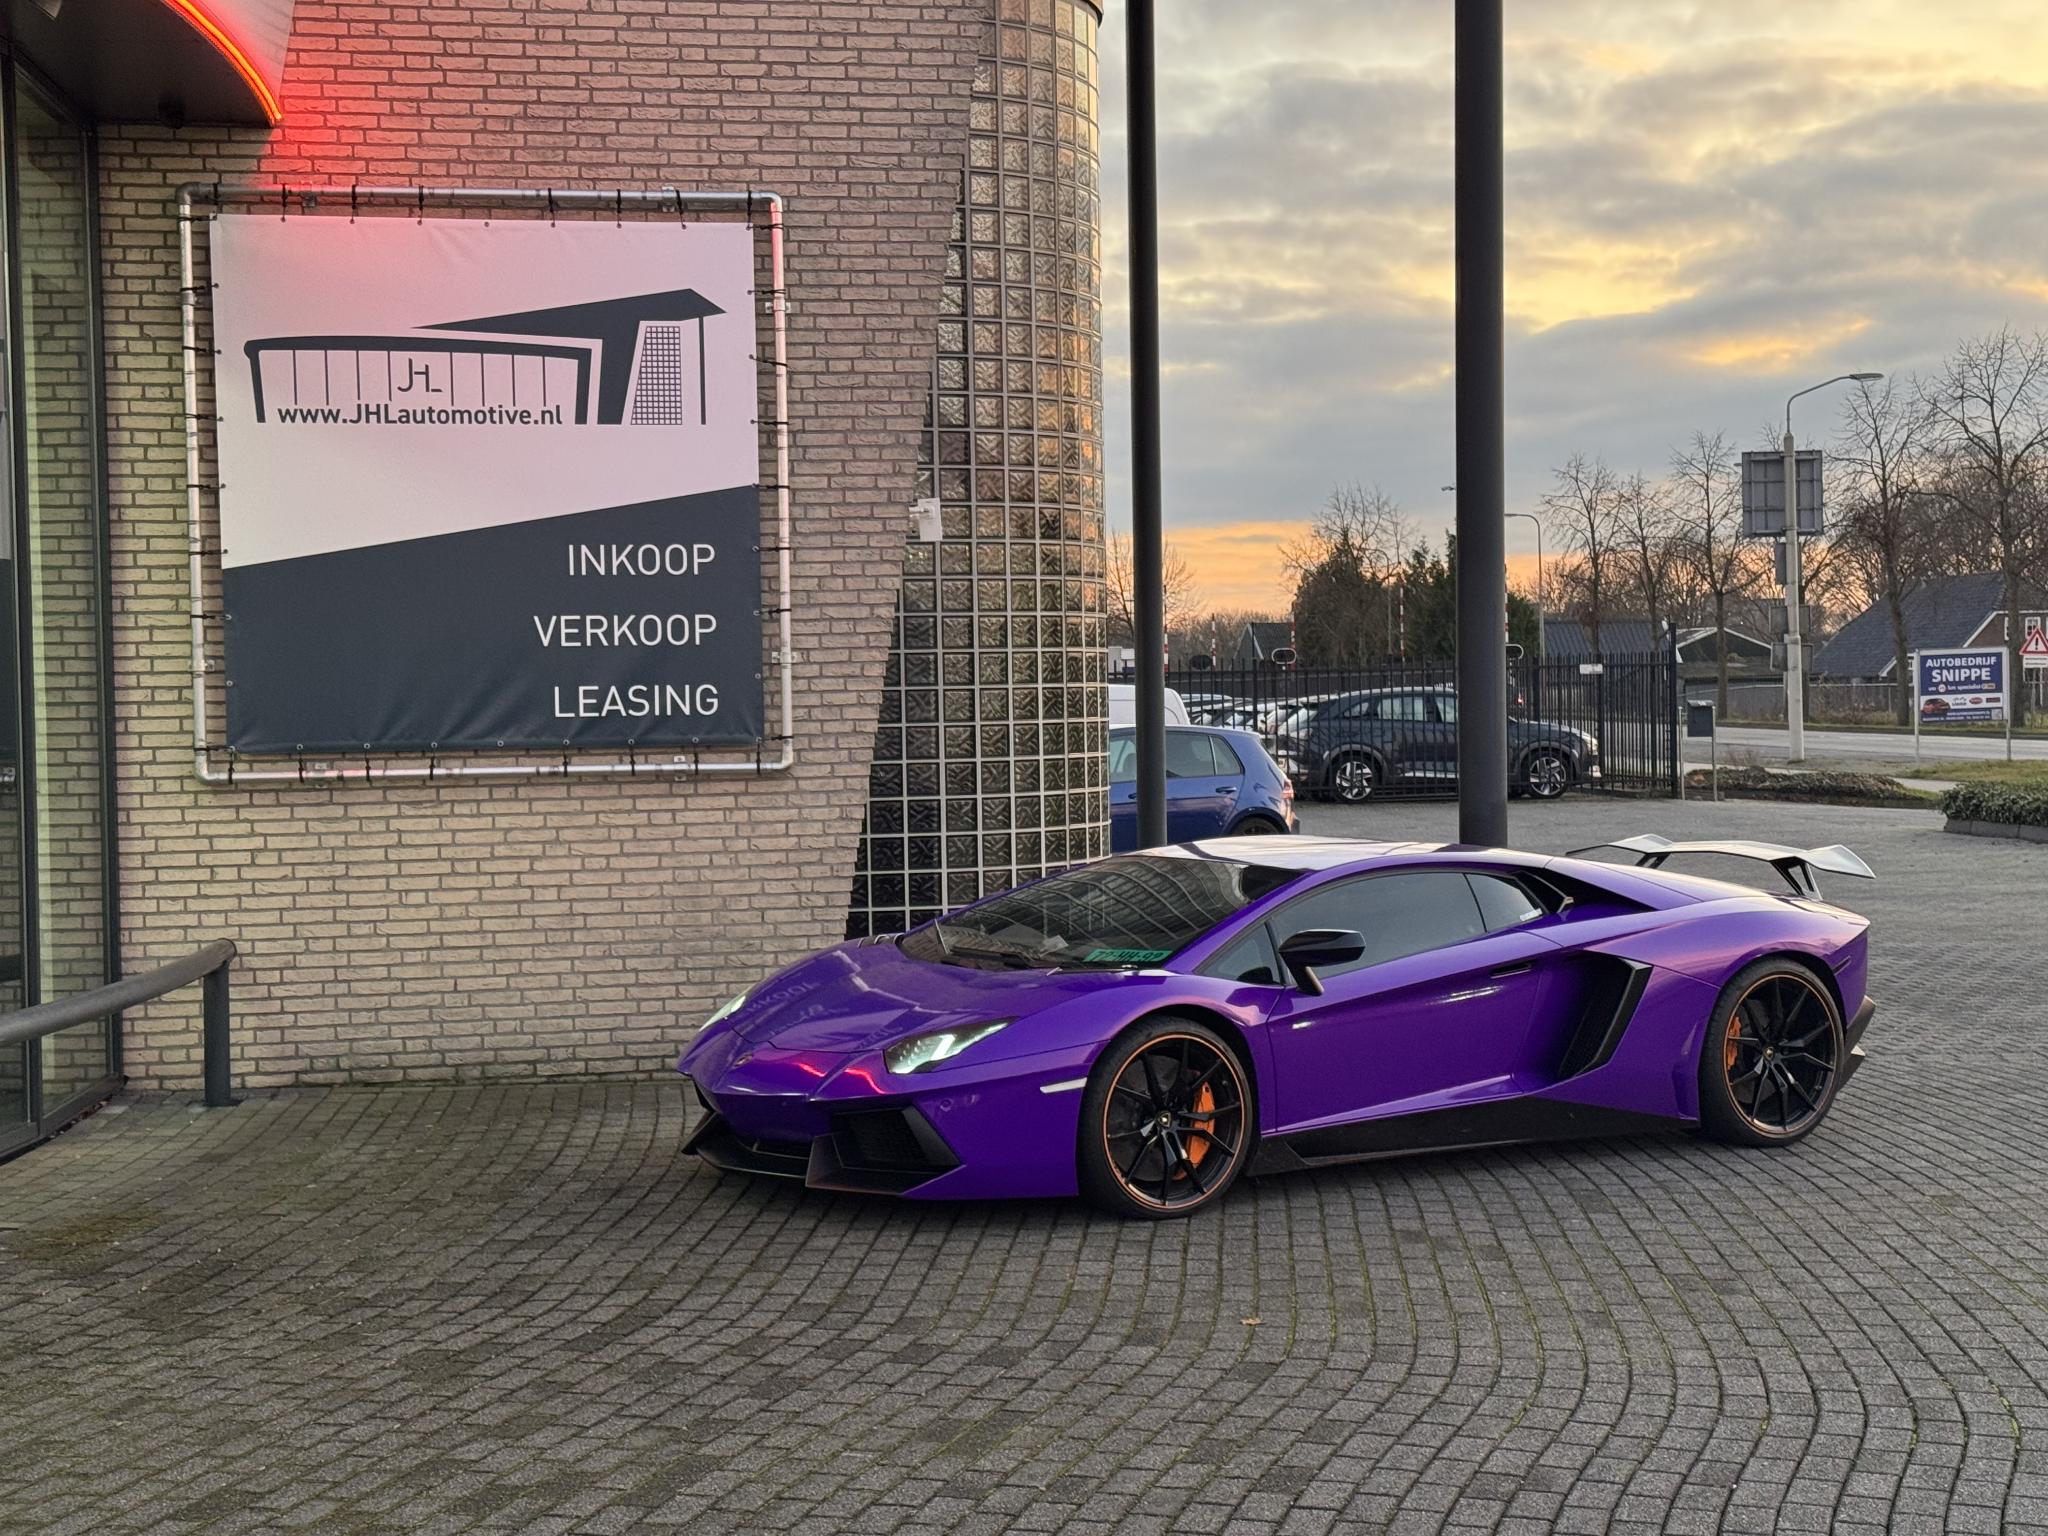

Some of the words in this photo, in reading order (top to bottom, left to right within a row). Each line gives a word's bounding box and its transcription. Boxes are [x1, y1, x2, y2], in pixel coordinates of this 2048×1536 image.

[397, 358, 443, 393] JHL
[277, 403, 563, 427] www.JHLautomotive.nl
[568, 543, 716, 576] INKOOP
[533, 614, 718, 647] VERKOOP
[1926, 657, 1996, 667] AUTOBEDRIJF
[1932, 668, 1991, 682] SNIPPE
[553, 684, 720, 718] LEASING
